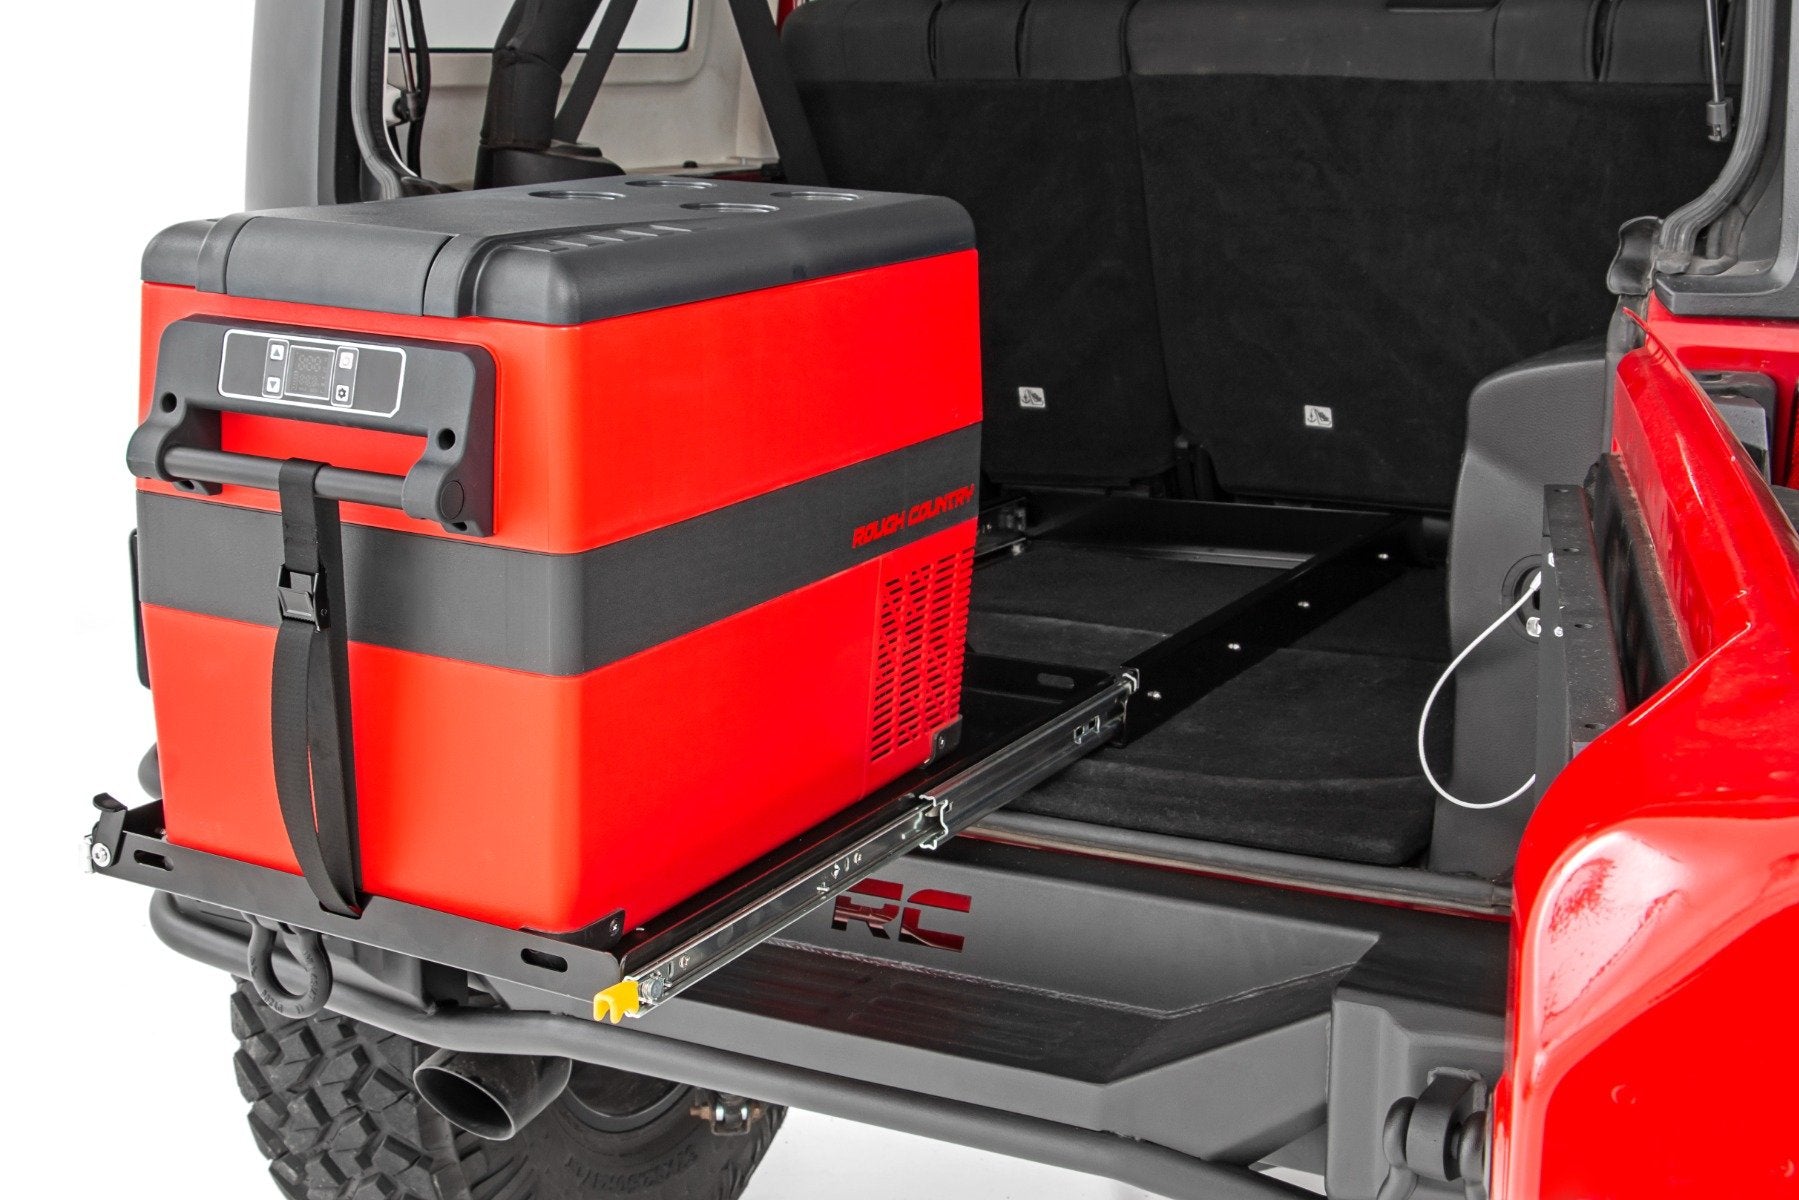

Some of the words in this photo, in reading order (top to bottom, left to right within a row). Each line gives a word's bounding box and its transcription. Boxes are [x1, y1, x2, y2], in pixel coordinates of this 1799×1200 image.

[853, 510, 905, 548] ROUGH
[908, 483, 975, 526] COUNTRY
[831, 877, 972, 953] RC
